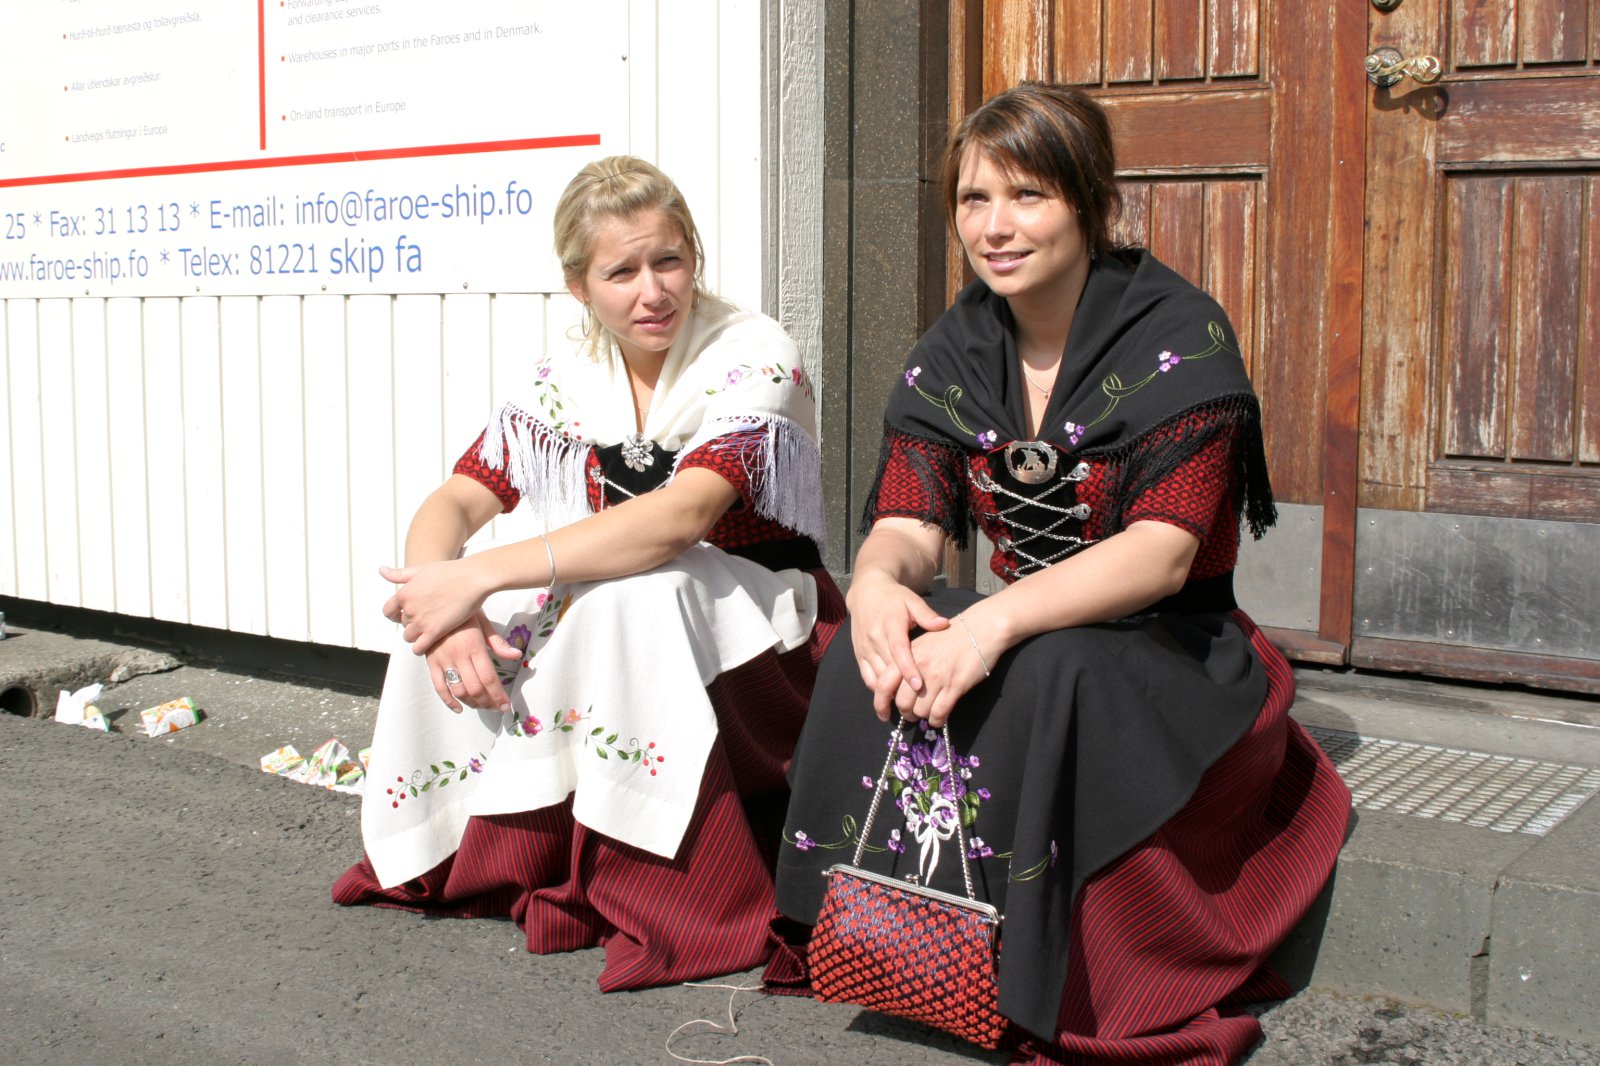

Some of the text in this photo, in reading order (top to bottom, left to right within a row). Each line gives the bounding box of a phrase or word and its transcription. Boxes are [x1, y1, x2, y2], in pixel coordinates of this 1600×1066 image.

[143, 20, 152, 31] og
[288, 4, 383, 26] and clearance services.
[288, 22, 543, 64] Warehouses in major ports in the Faroes and in Denmark.
[290, 101, 406, 121] On-land transport in Europe
[5, 212, 26, 239] 25
[49, 210, 86, 237] Fax:
[95, 207, 116, 235] 31
[126, 204, 148, 233] 13
[158, 202, 181, 231] 13
[210, 195, 284, 229] E-mail:
[296, 180, 532, 226] info@faroe-ship.fo
[178, 246, 239, 276] Telex:
[250, 243, 318, 275] 81221
[330, 237, 384, 282] skip
[395, 235, 421, 272] fa
